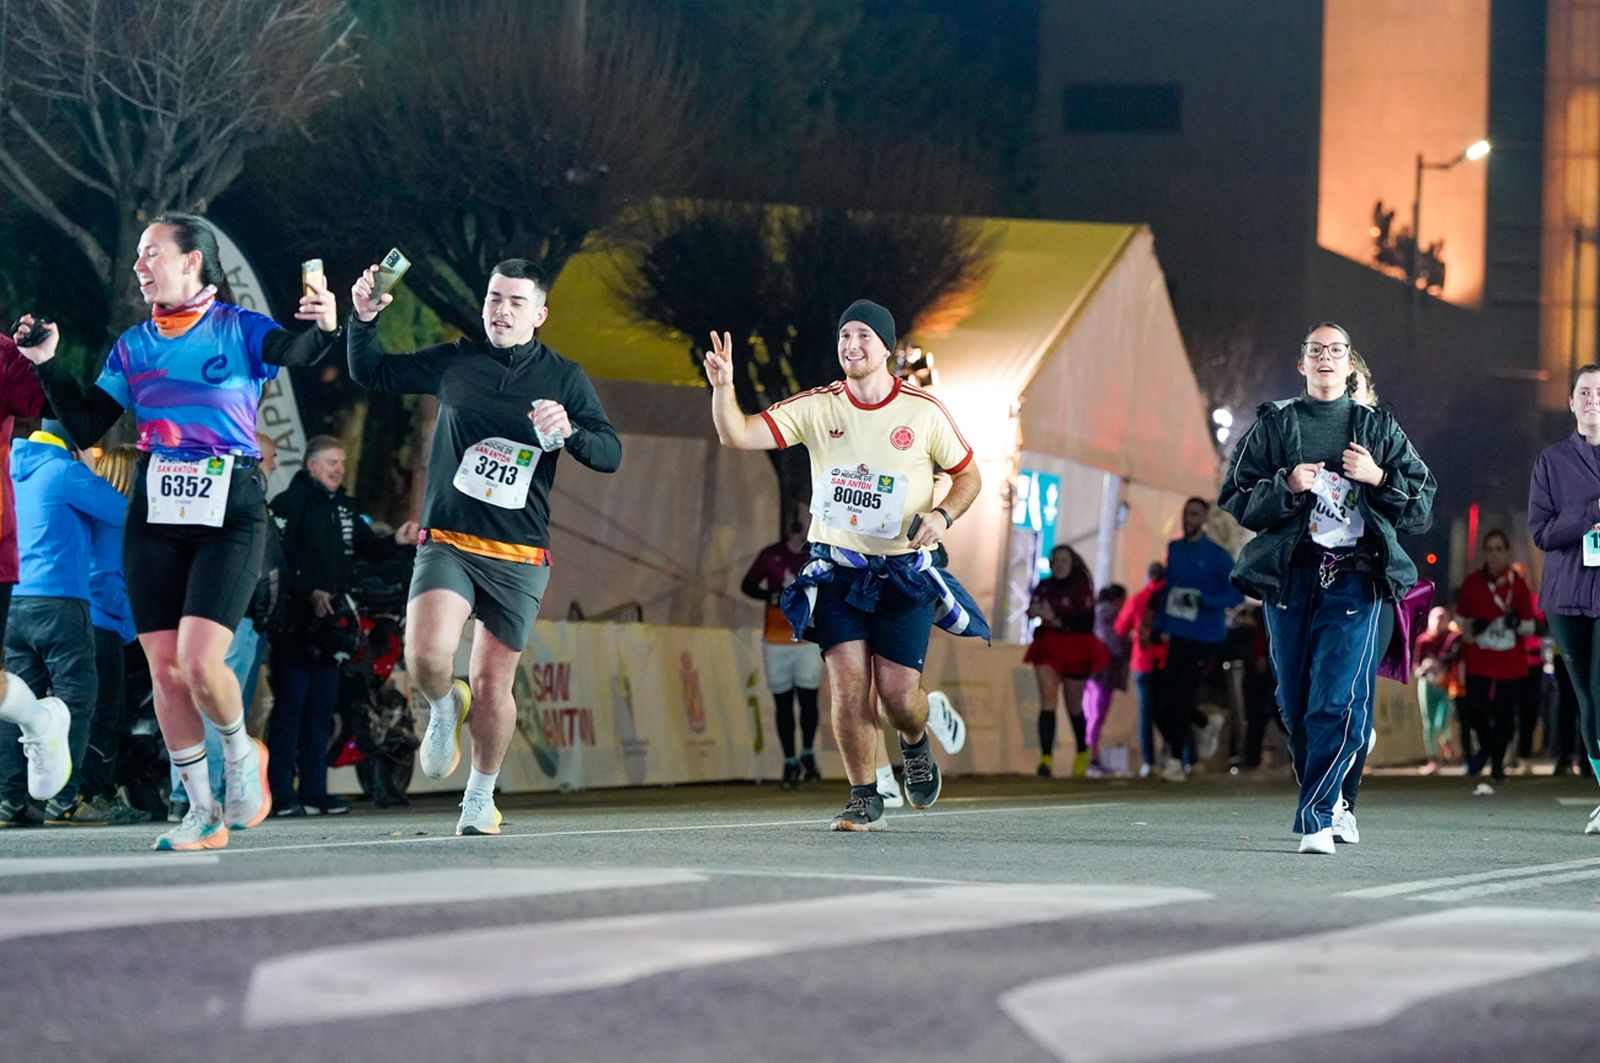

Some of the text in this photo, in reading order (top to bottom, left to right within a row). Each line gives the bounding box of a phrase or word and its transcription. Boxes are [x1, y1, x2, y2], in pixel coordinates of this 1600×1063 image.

[475, 455, 518, 486] 3213
[831, 477, 846, 485] SAN
[160, 474, 213, 498] 6352
[833, 486, 882, 509] 80085
[532, 661, 572, 702] SAN
